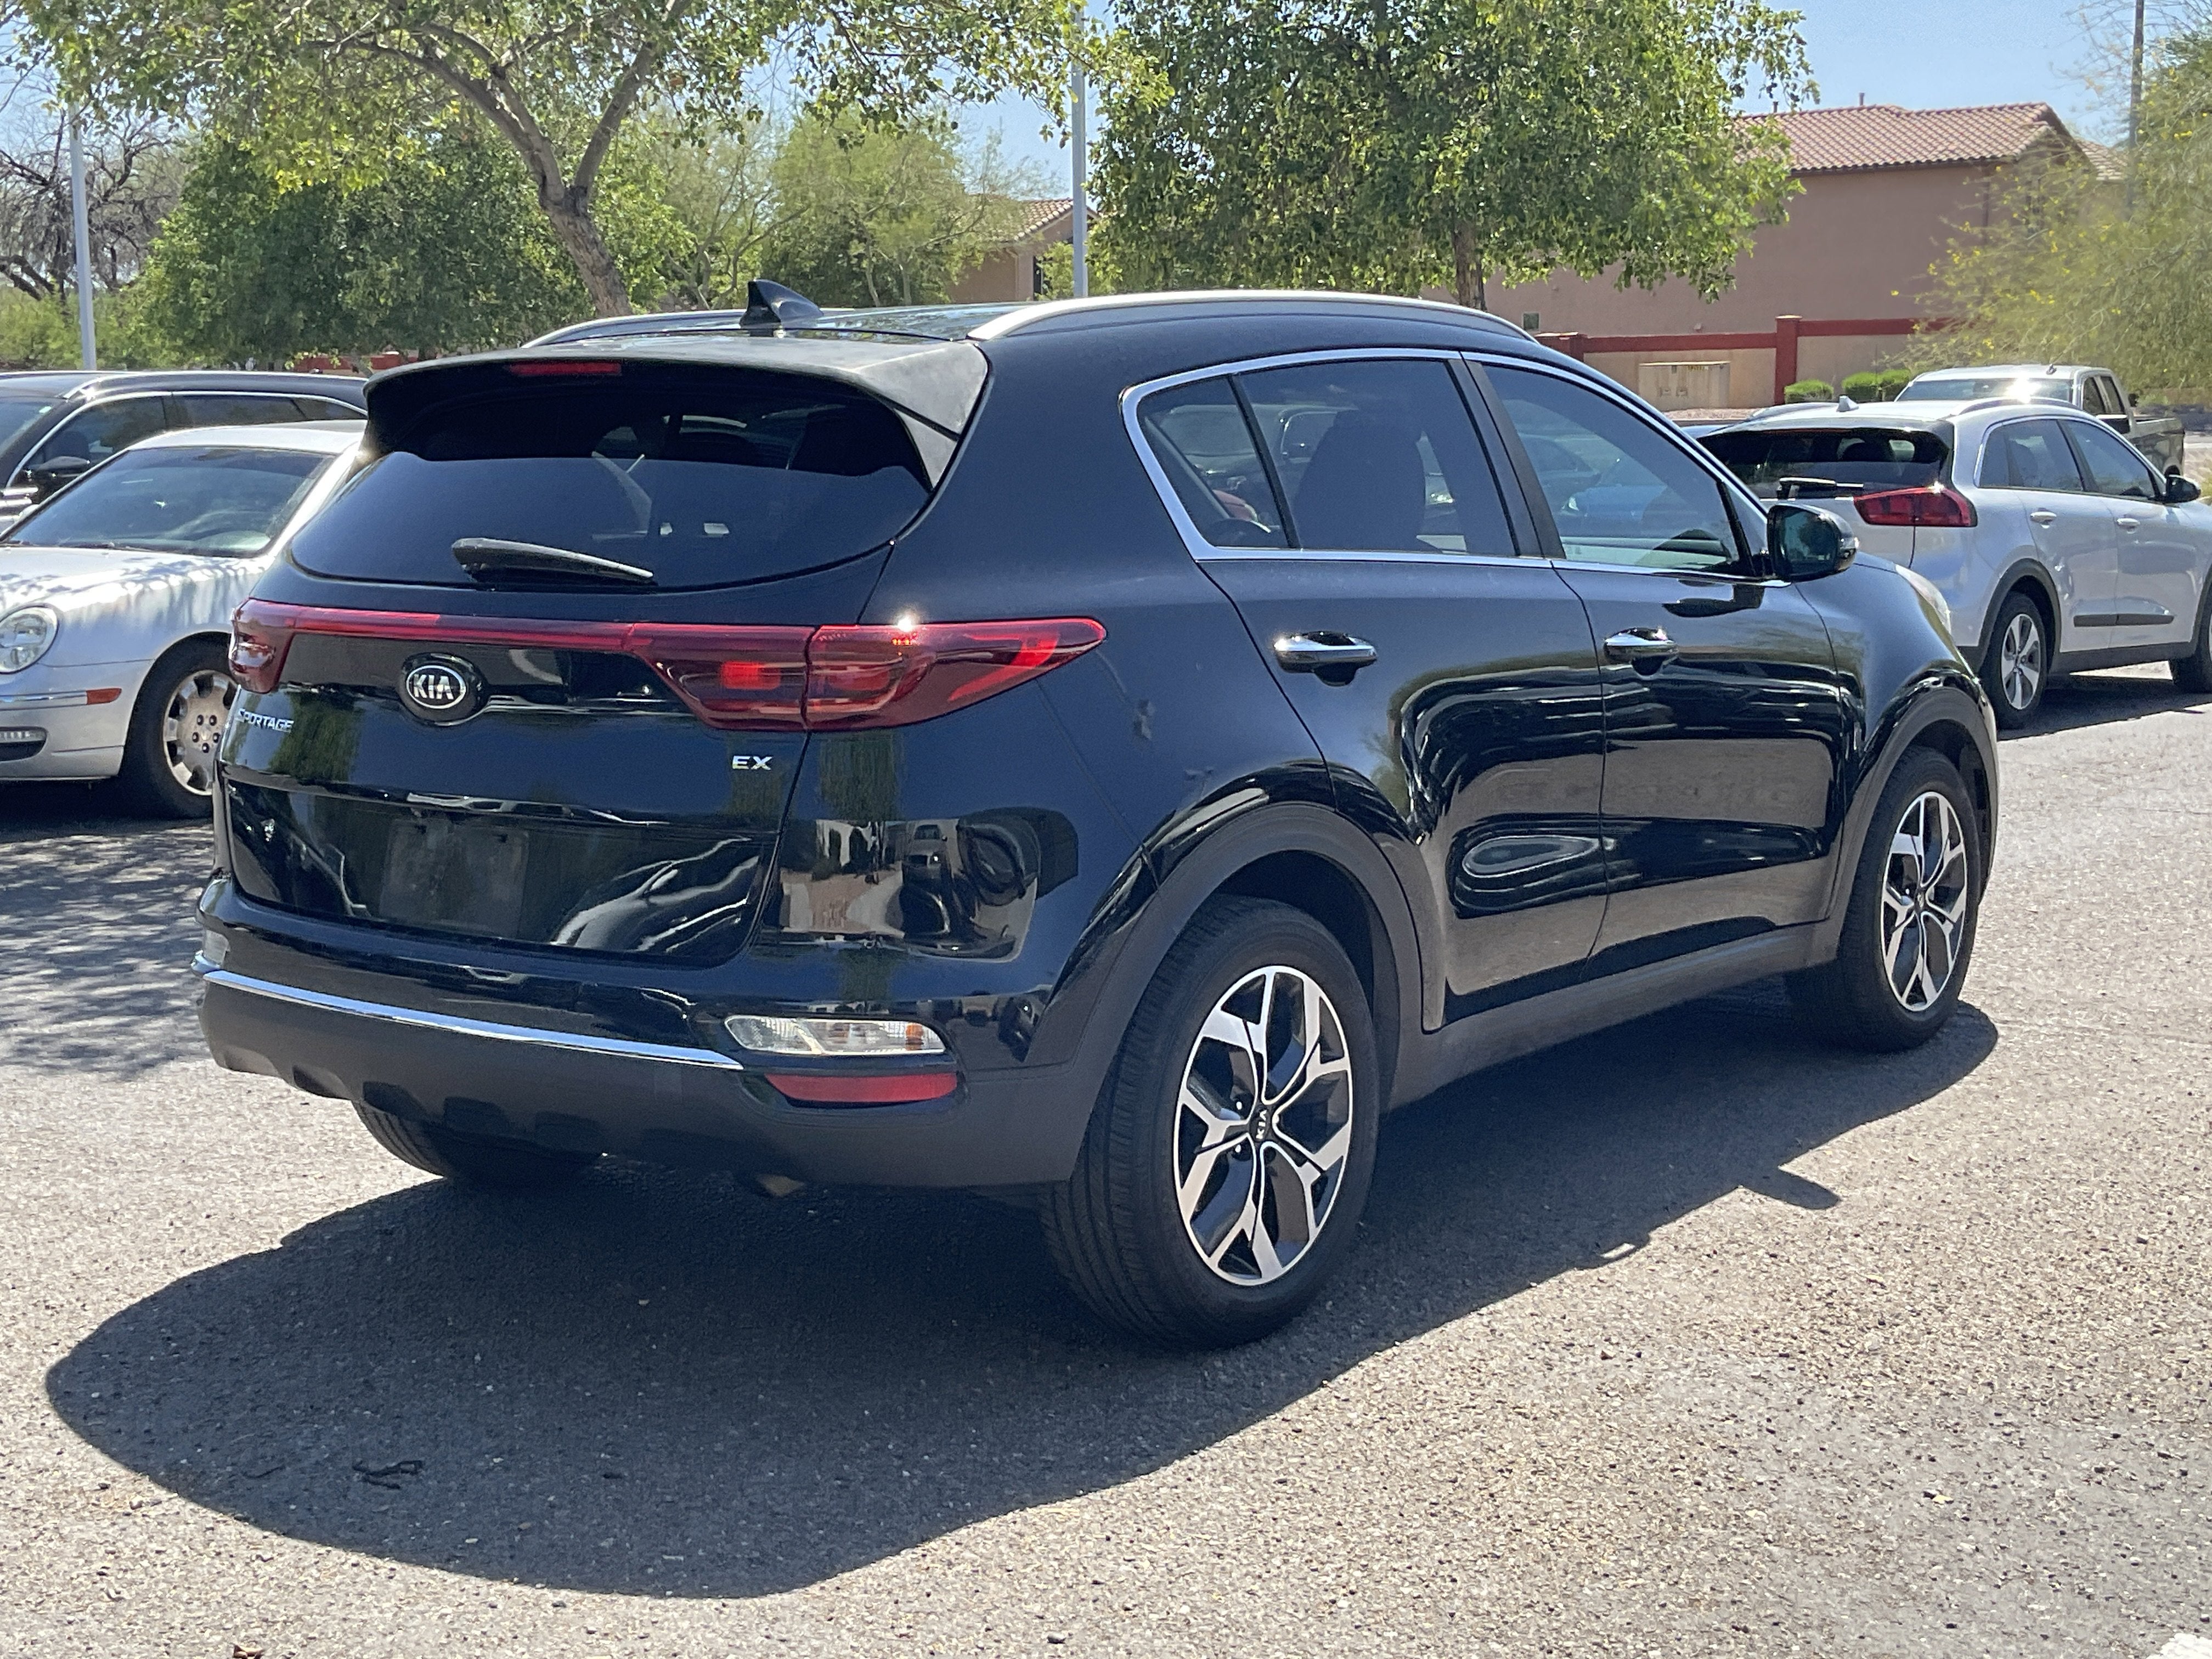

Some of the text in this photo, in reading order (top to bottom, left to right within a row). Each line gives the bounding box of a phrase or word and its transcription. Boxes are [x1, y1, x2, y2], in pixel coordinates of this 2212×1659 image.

[413, 674, 454, 699] KIA
[235, 708, 294, 732] SPORTAGE
[732, 755, 772, 770] EX
[1256, 1109, 1267, 1139] KIA
